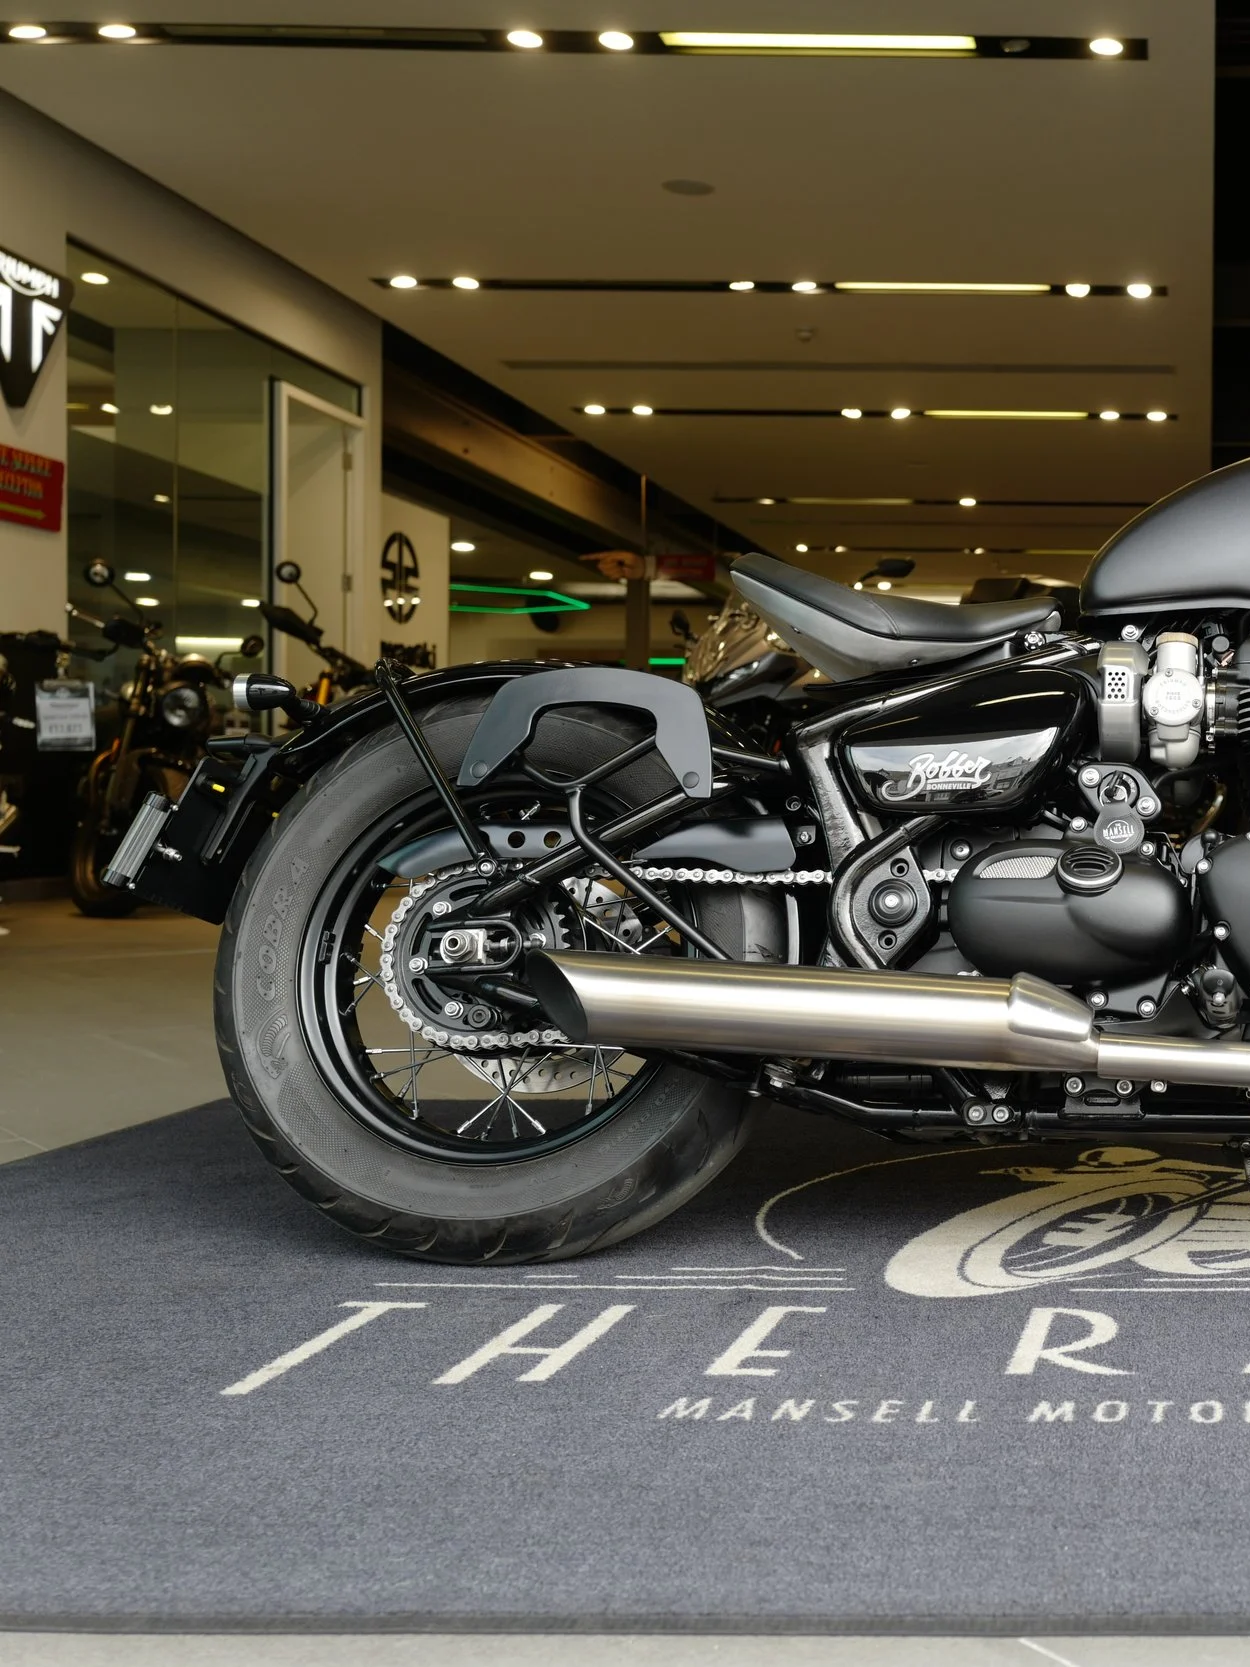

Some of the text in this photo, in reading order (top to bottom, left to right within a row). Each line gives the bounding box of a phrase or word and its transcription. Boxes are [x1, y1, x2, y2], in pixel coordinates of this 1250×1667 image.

[0, 251, 59, 299] RIUMPH
[881, 750, 992, 802] Bobber
[926, 782, 972, 791] BONNEVILLE
[1102, 825, 1135, 837] MANSELL
[255, 853, 311, 1002] COBRA
[219, 1300, 829, 1396] THE
[656, 1396, 982, 1426] MANSELL
